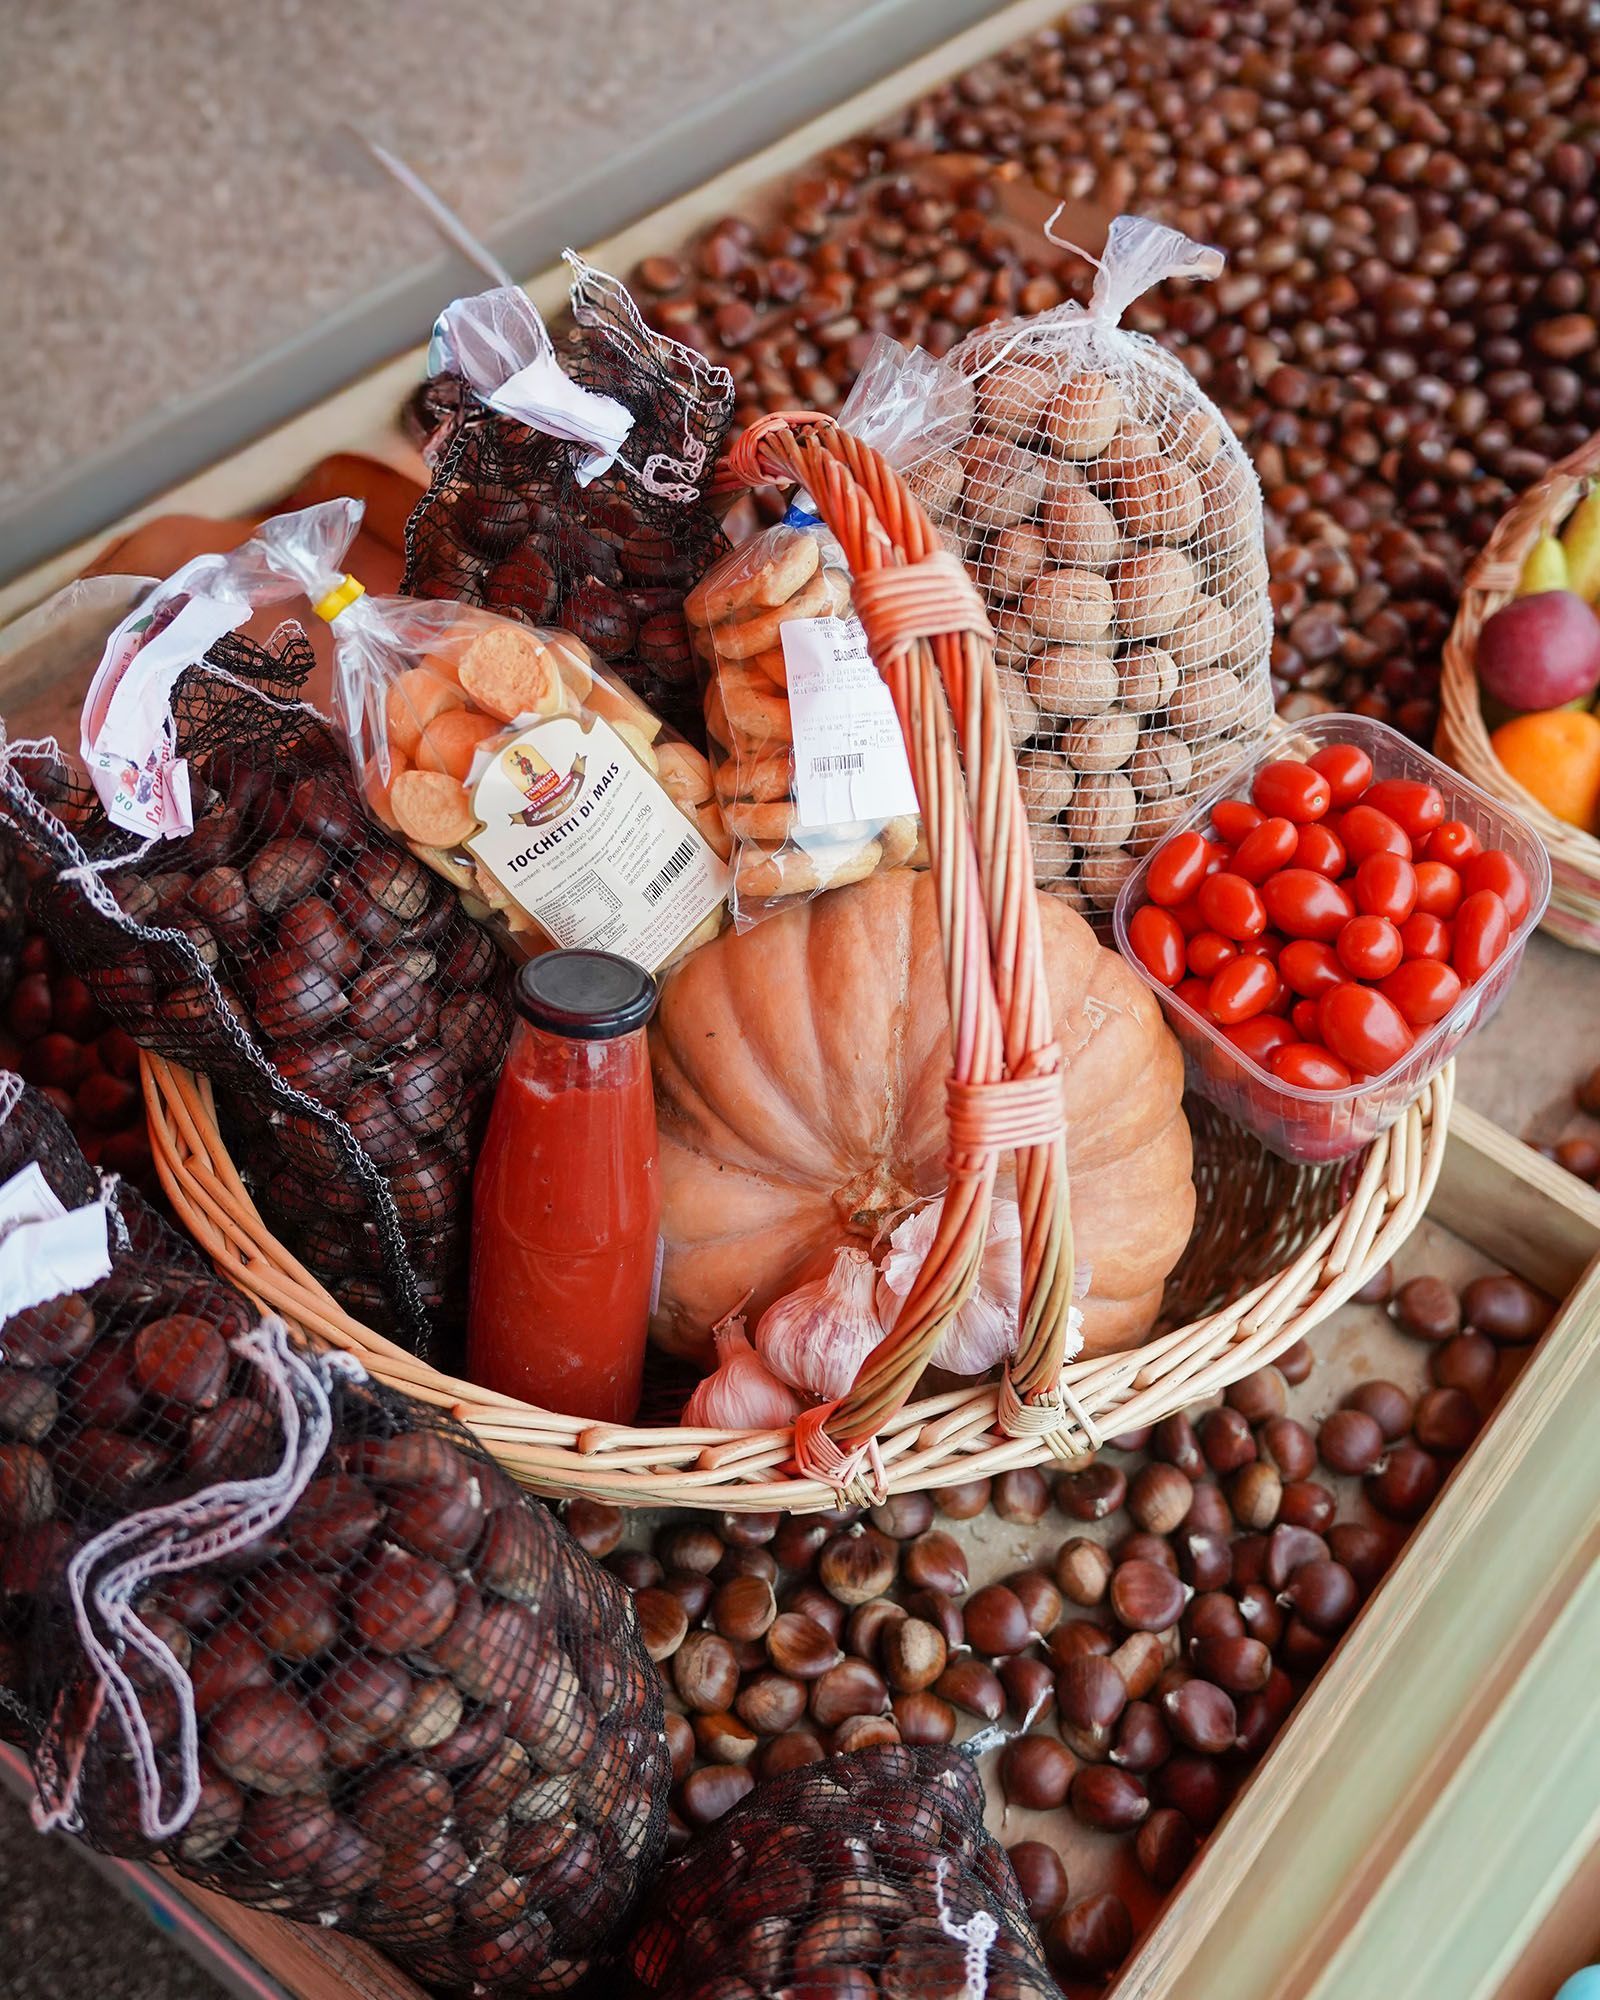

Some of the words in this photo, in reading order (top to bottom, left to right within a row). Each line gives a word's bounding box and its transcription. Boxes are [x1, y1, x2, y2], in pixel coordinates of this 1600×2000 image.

[526, 770, 555, 796] PANIFICIO
[507, 816, 579, 872] TOCCHETTI
[579, 800, 594, 818] DI
[593, 762, 620, 800] MAIS
[564, 831, 586, 851] GRANO
[606, 844, 622, 862] Peso
[634, 803, 651, 824] 350g
[677, 873, 698, 894] Tusciano
